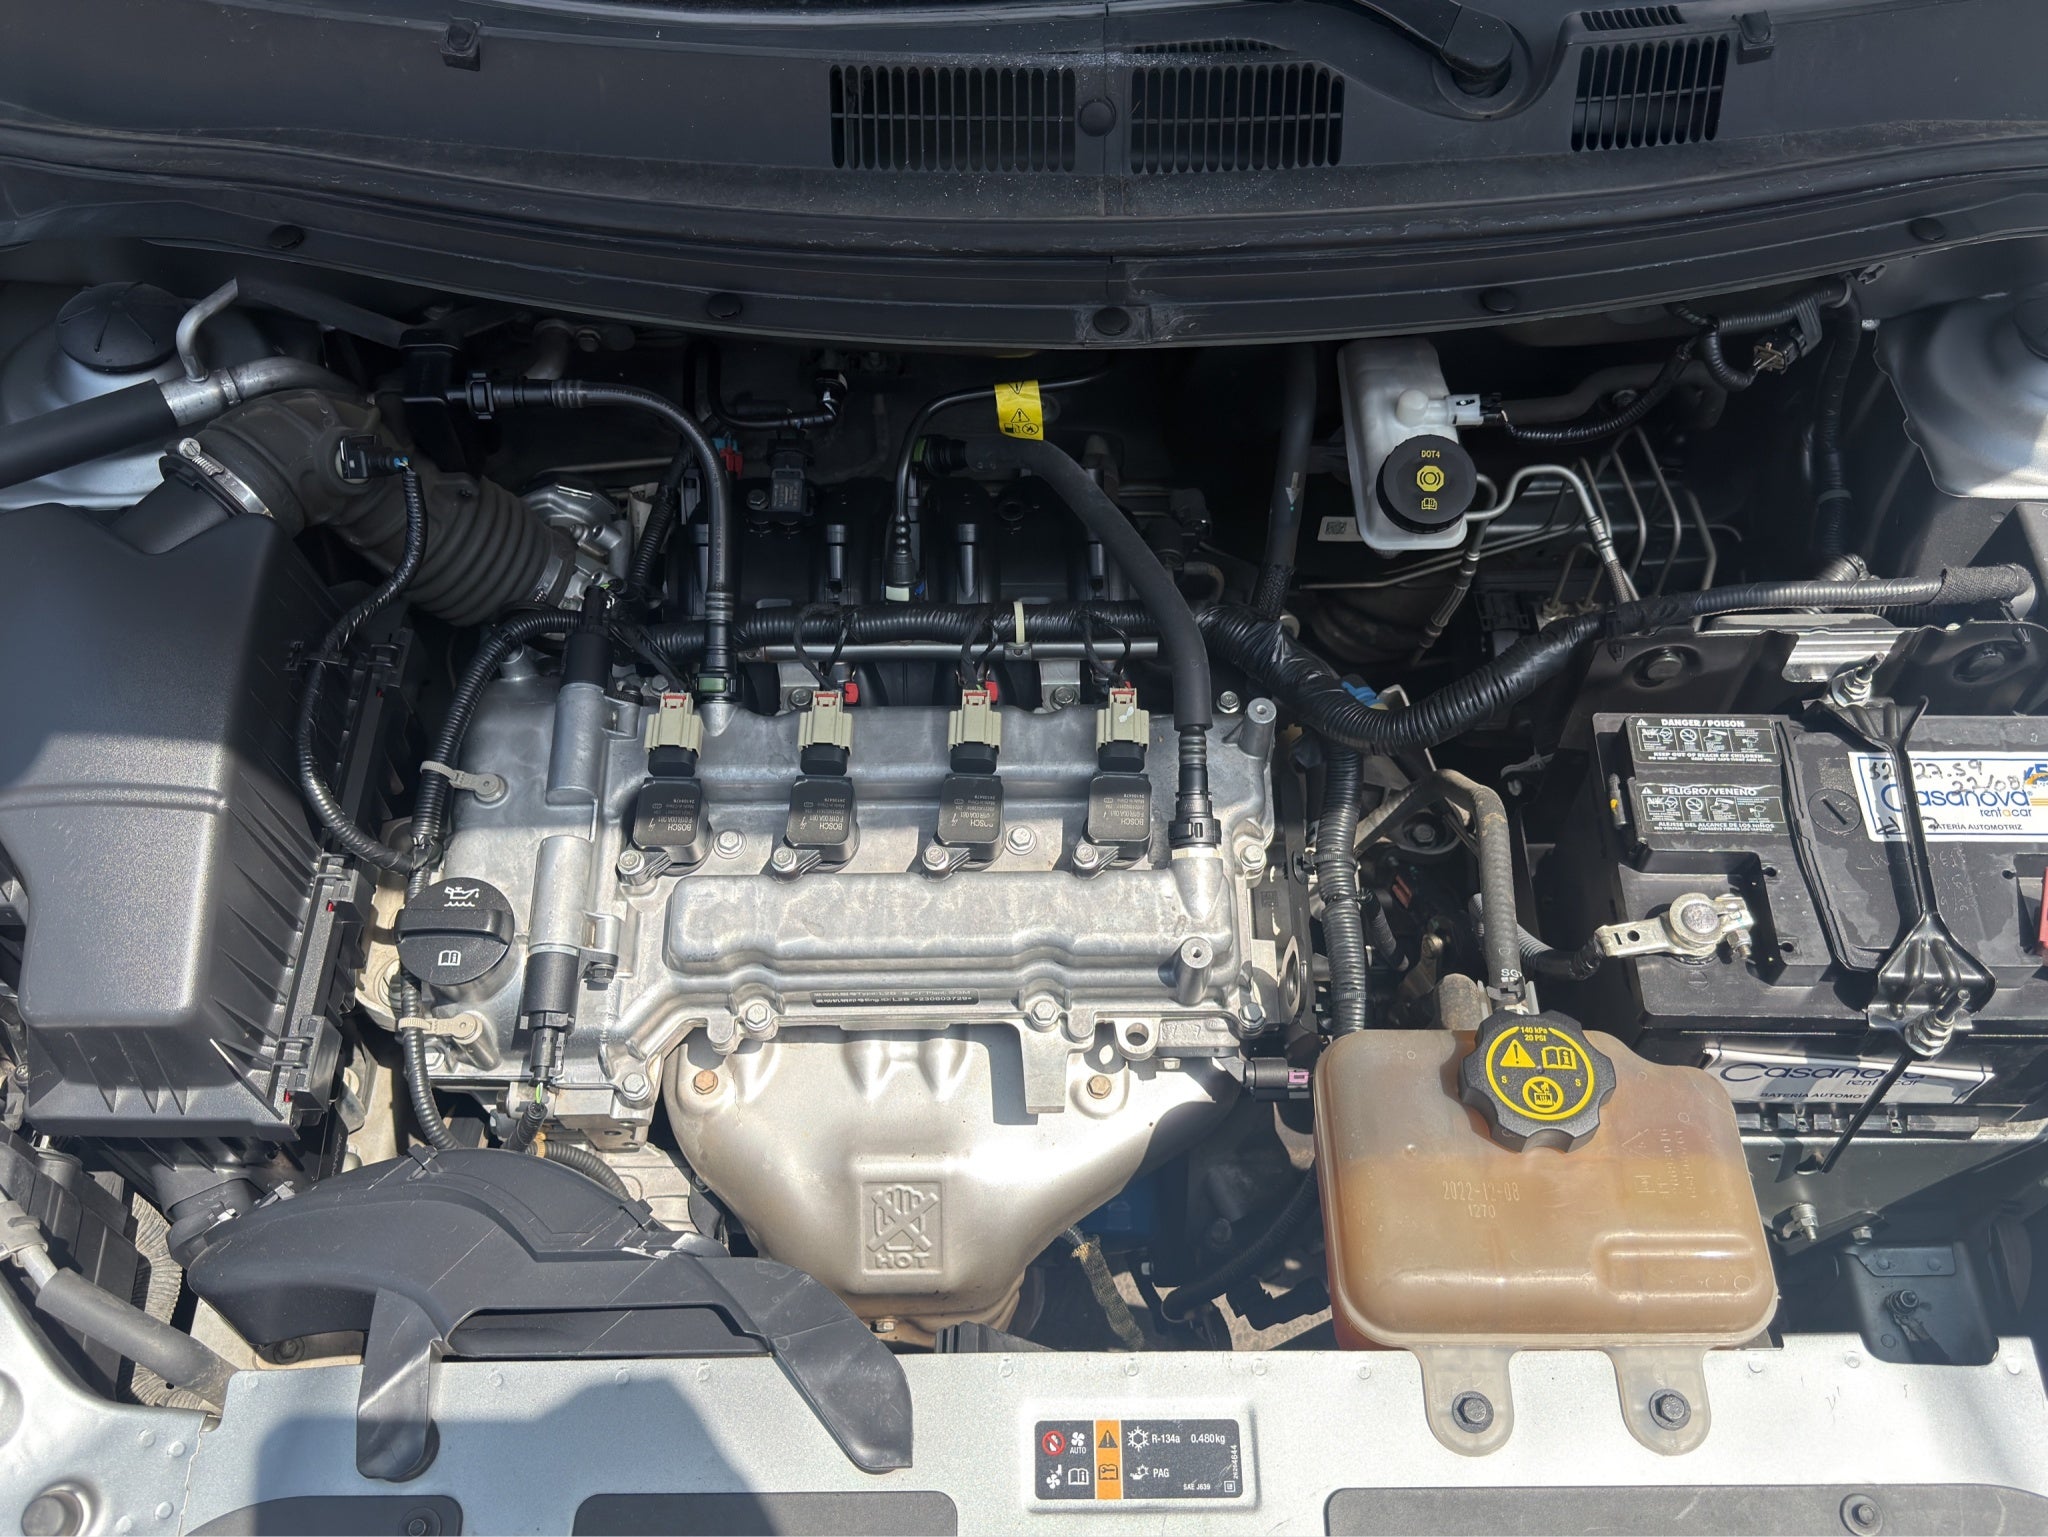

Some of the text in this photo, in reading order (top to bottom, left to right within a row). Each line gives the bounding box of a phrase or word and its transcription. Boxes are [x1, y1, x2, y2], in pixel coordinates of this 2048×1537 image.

[1421, 450, 1441, 459] DOT4
[1120, 817, 1144, 826] BOSCH
[667, 823, 692, 832] BOSCH
[819, 822, 843, 831] BOSCH
[1968, 823, 2023, 831] AUTOMOTRIZ
[1520, 1026, 1533, 1034] 140
[1524, 1034, 1547, 1042] 20 PSI
[1845, 1077, 1921, 1087] rentcar
[1442, 1180, 1521, 1202] 2022-12-08
[875, 1252, 930, 1269] HOT
[1151, 1434, 1181, 1444] R-134a
[1069, 1446, 1087, 1455] AUTO
[1153, 1468, 1170, 1479] PAG
[1183, 1483, 1195, 1491] SAE
